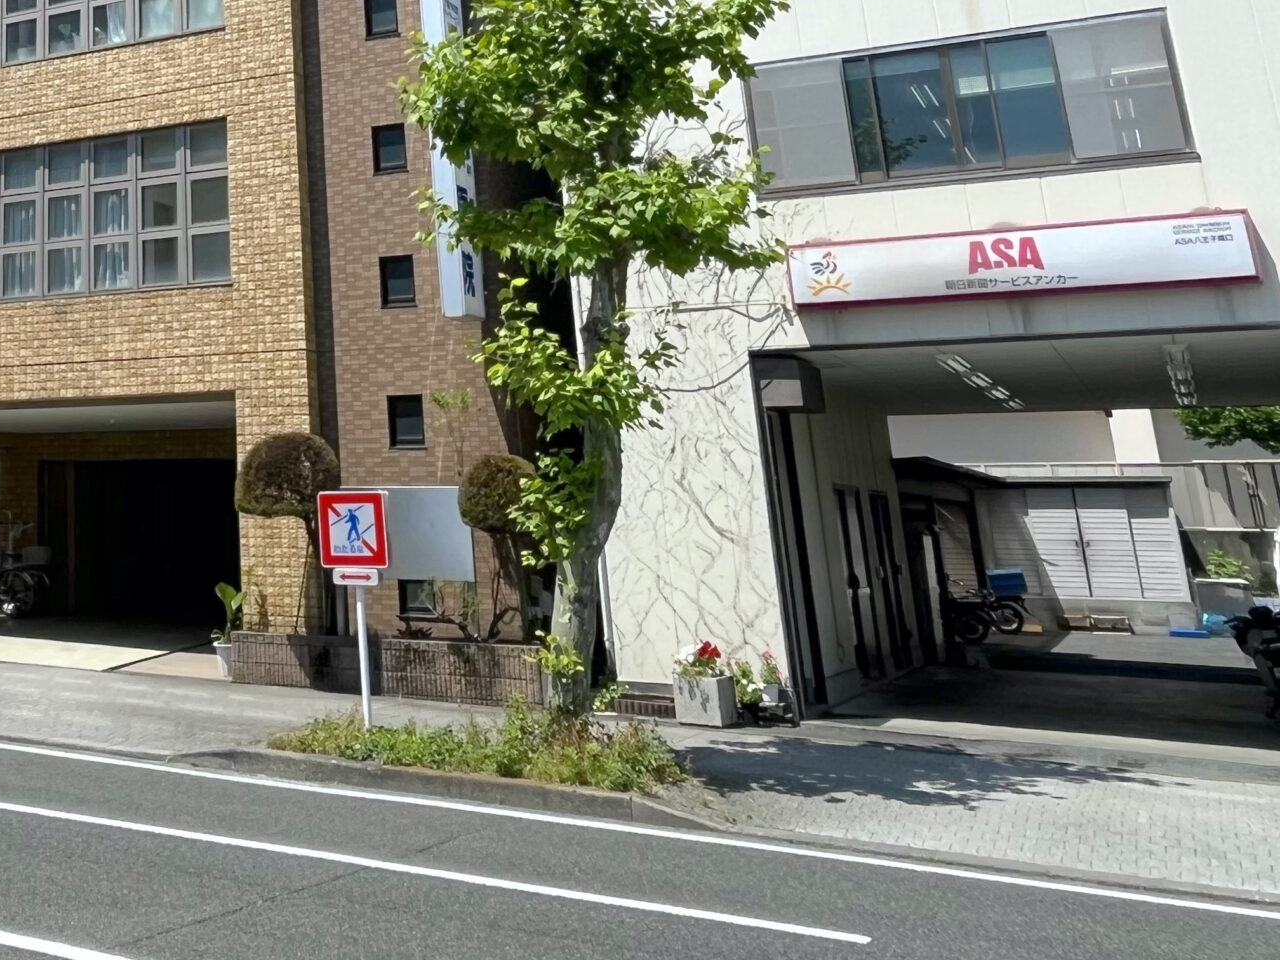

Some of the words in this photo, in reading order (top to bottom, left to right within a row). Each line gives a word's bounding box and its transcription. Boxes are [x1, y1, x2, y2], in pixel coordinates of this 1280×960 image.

[968, 236, 1045, 275] ASA
[944, 274, 1079, 291] 朝日新聞サービスアンカー
